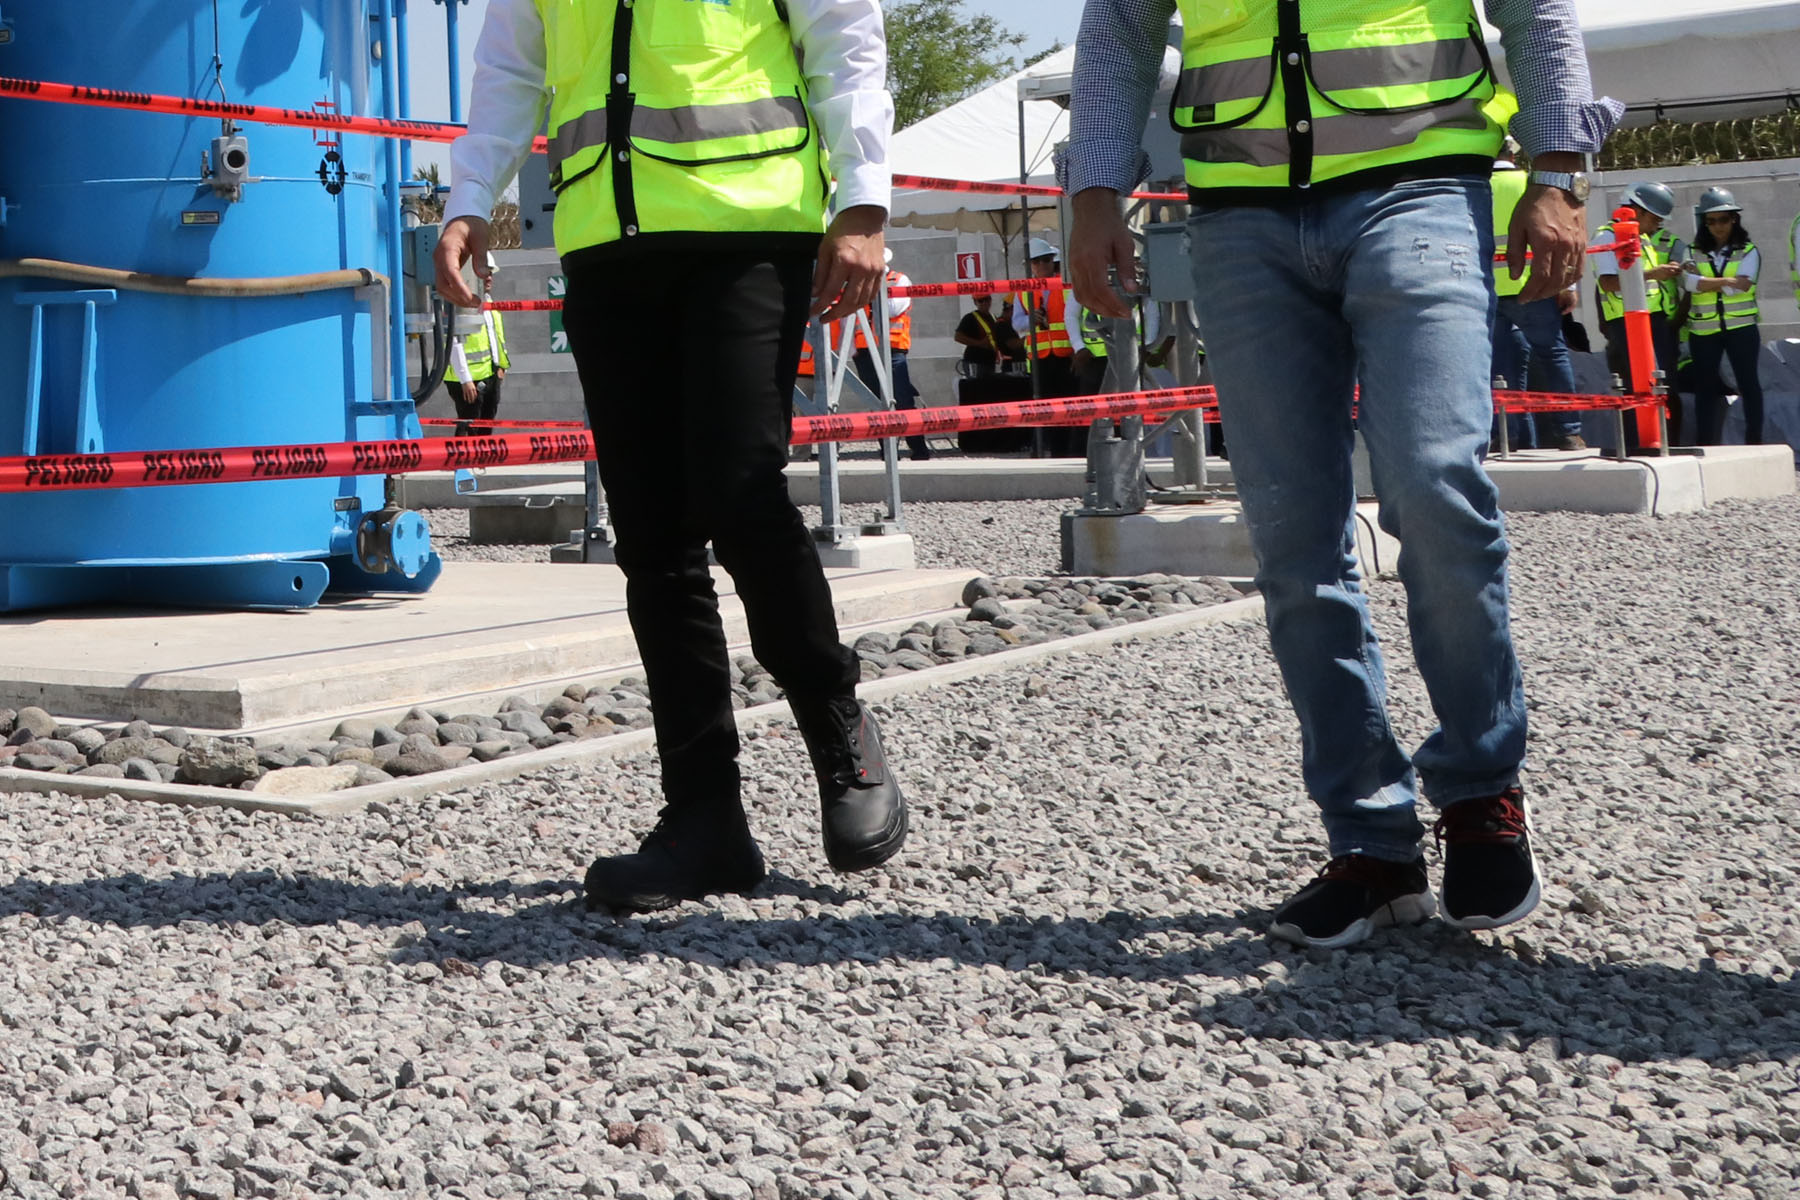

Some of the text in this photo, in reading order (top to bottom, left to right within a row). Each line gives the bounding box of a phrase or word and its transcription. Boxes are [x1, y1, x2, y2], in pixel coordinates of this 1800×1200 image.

[808, 417, 854, 441] PELIGRO
[866, 413, 910, 437] PELIGRO
[920, 409, 961, 433] PELIGRO
[251, 447, 328, 477] PELIGRO
[352, 442, 423, 472] PELIGRO
[444, 438, 509, 468] PELIGRO
[529, 433, 589, 462] PELIGRO
[24, 455, 114, 487] PELIGRO
[143, 450, 226, 482] PELIGRO
